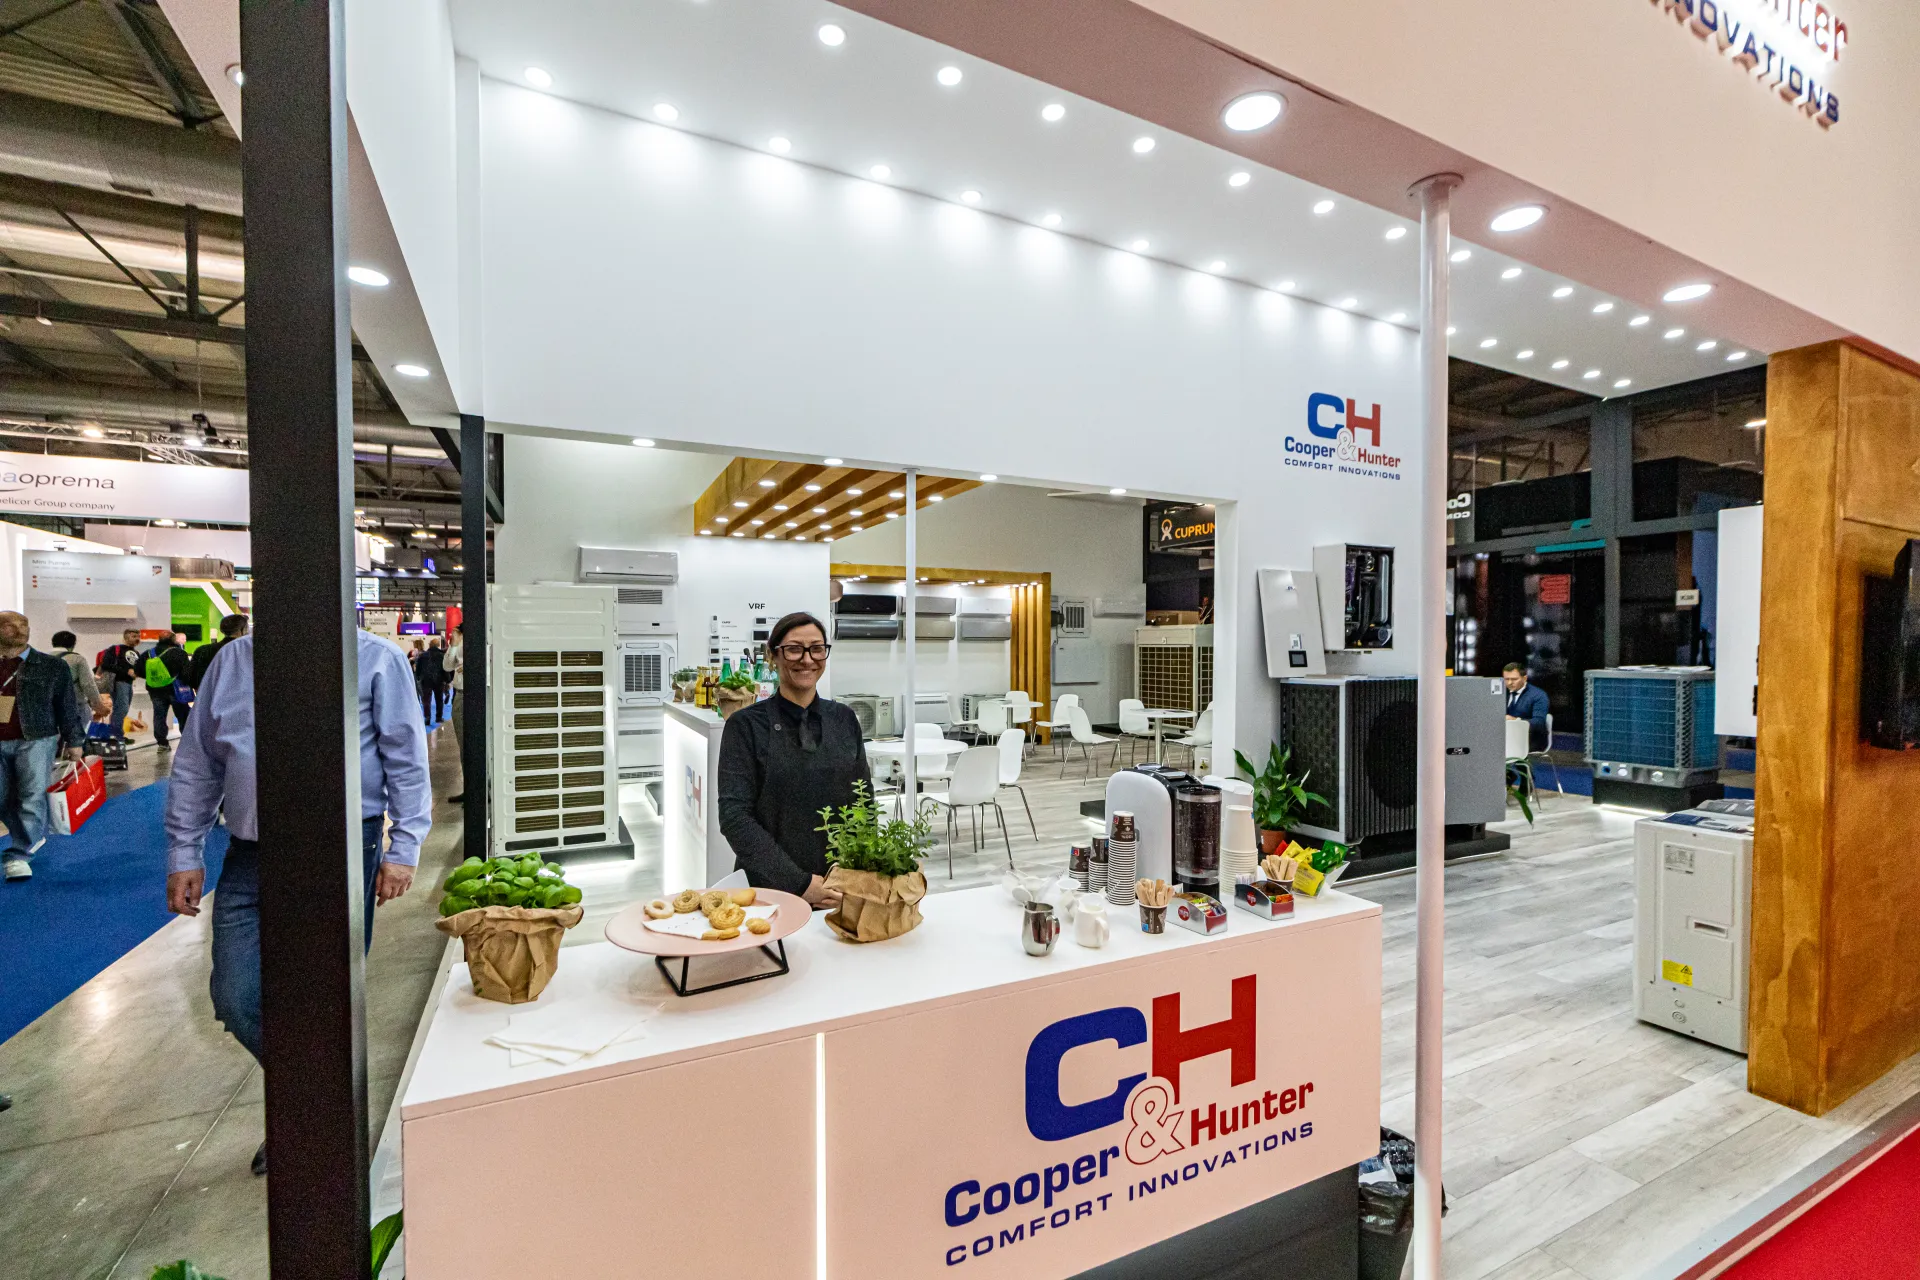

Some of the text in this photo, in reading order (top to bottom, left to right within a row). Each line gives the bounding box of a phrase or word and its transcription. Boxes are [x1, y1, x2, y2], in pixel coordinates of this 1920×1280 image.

[1307, 392, 1381, 447] CH
[1284, 436, 1336, 460] Cooper
[1357, 447, 1401, 468] Hunter
[0, 471, 115, 490] aoprema
[1284, 458, 1401, 481] COMFORT INNOVATIONS
[0, 496, 115, 512] elicor Group company
[748, 602, 766, 610] VRF
[1025, 974, 1257, 1142] CH
[944, 1081, 1314, 1228] Cooper & Hunter
[945, 1121, 1314, 1267] COMFORT INNOVATIONS
